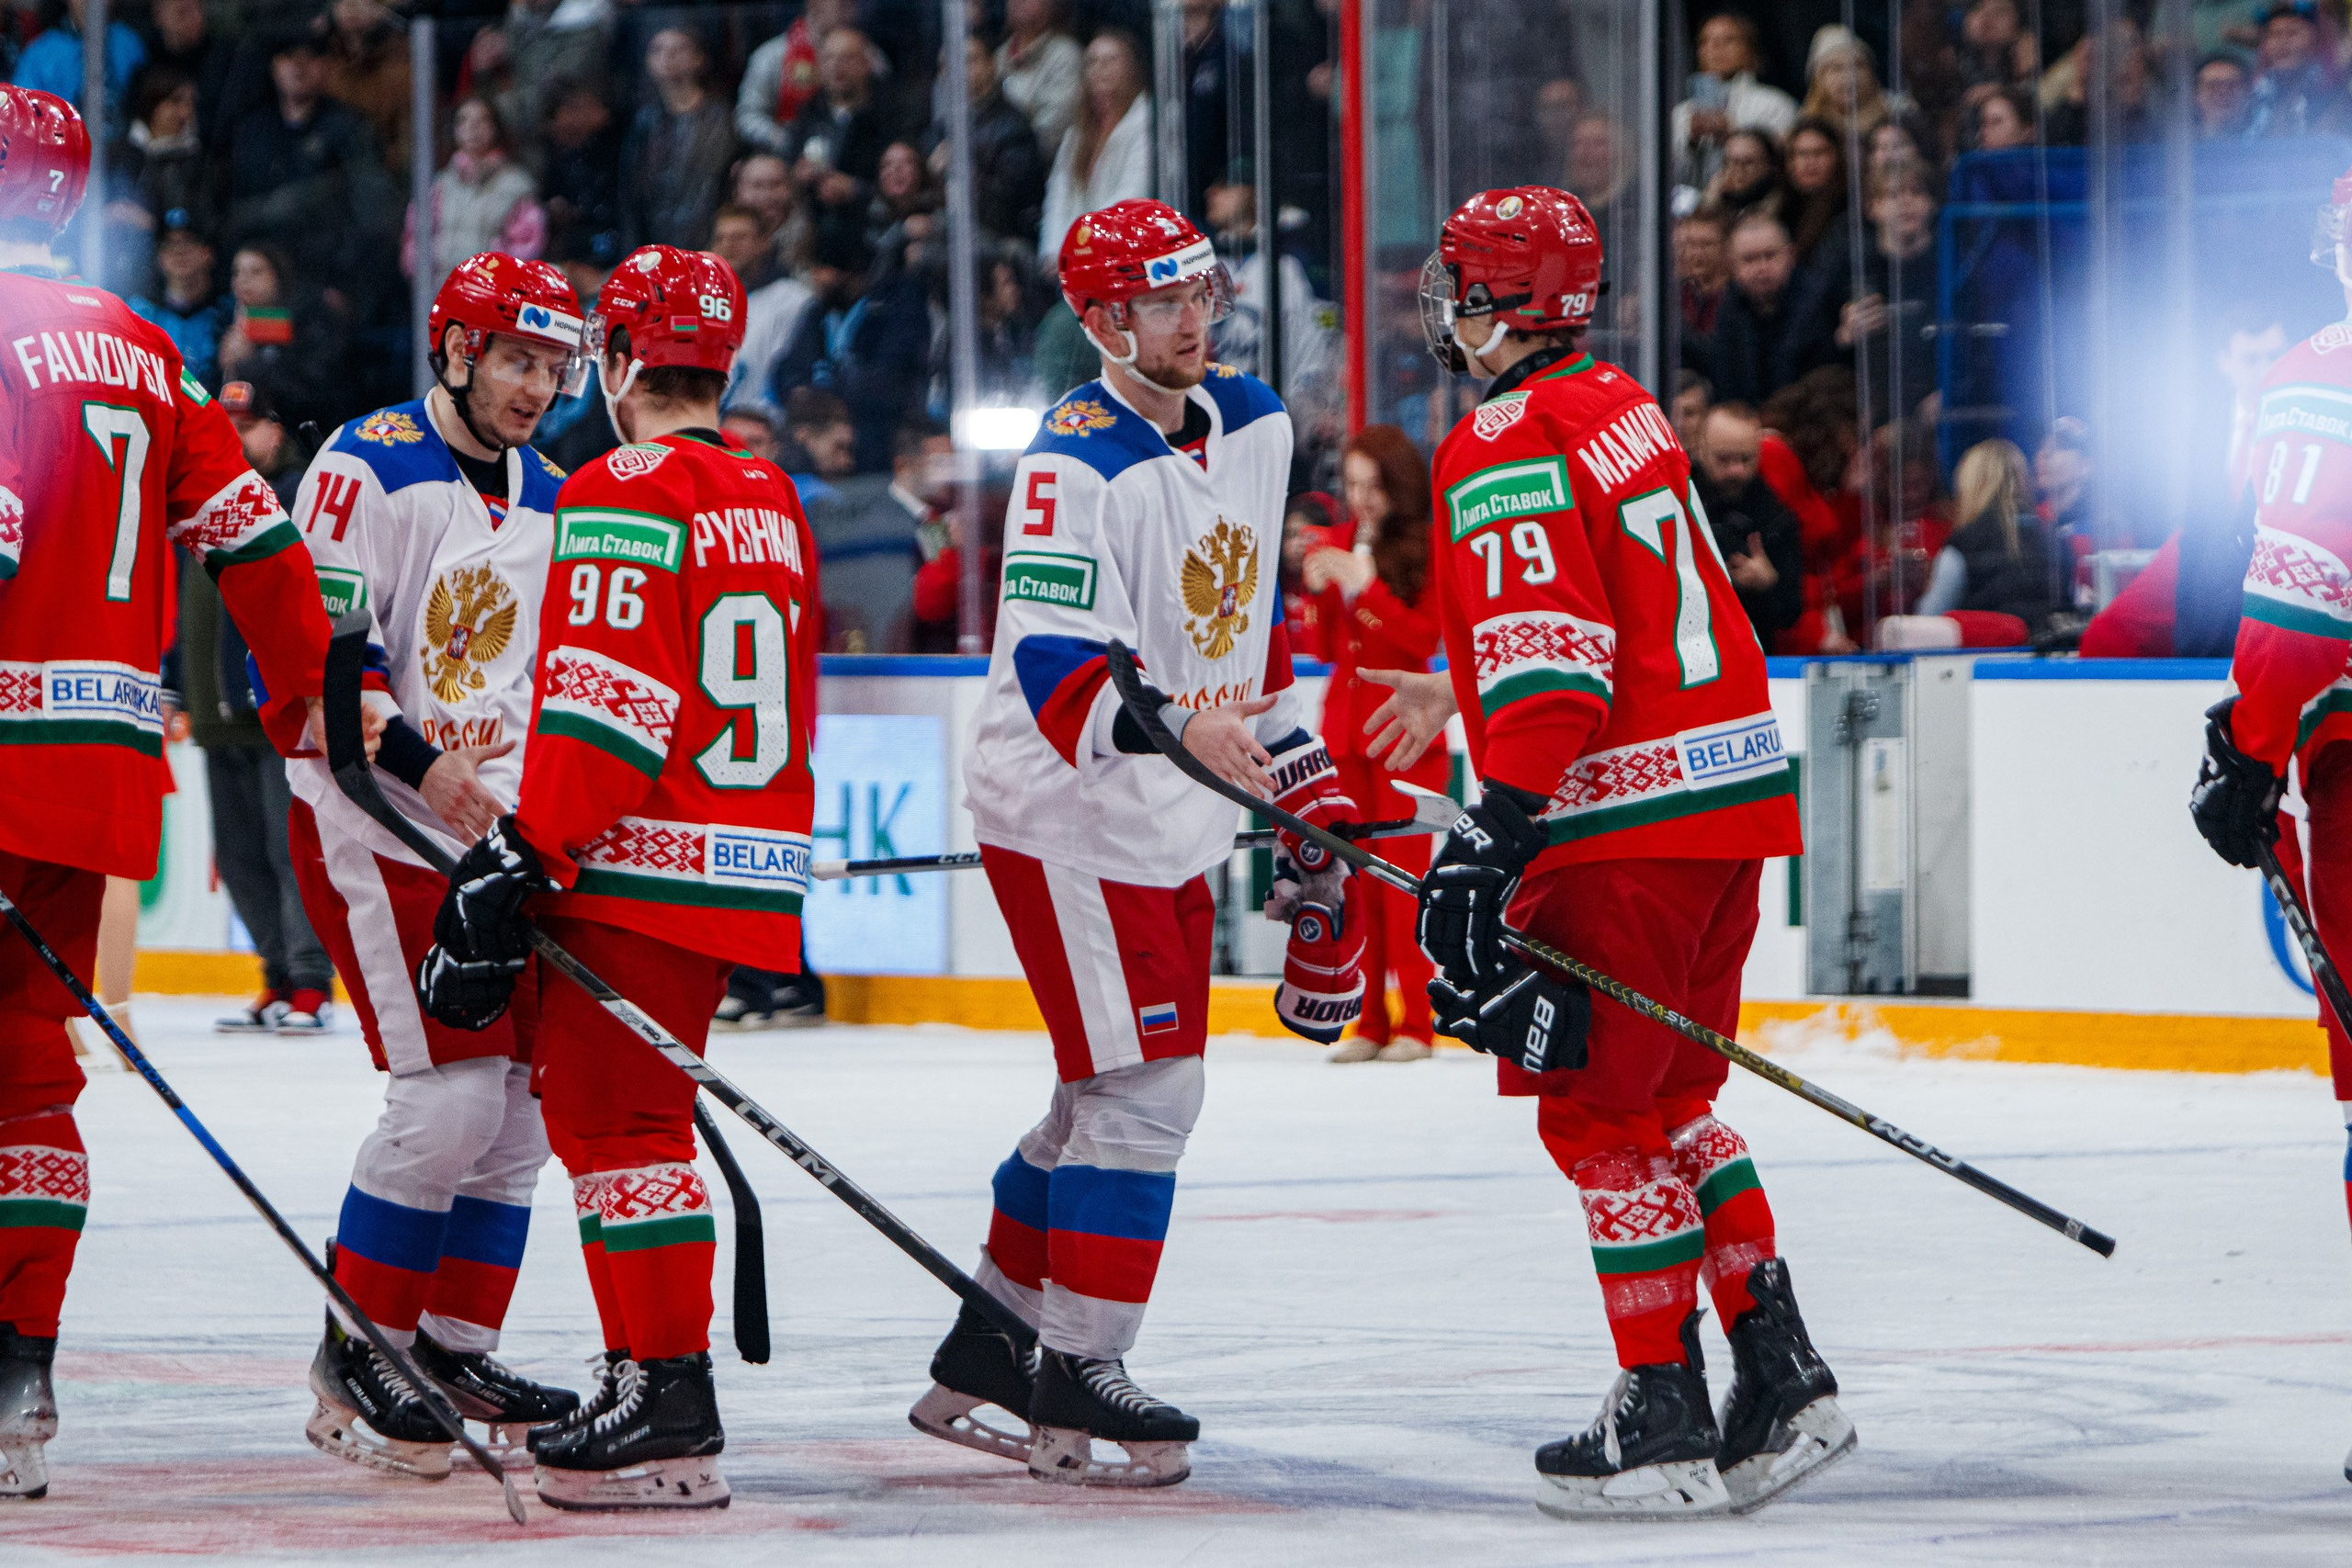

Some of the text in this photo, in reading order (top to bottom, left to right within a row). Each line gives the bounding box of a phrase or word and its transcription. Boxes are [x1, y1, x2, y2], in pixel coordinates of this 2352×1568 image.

[49, 169, 65, 193] 7
[611, 296, 638, 310] CCM
[698, 294, 732, 321] 96
[1560, 292, 1588, 318] 79
[81, 399, 152, 604] 7
[1022, 471, 1057, 537] 5
[2263, 439, 2324, 505] 81
[305, 470, 362, 544] 14
[1469, 520, 1558, 599] 79
[1617, 476, 1765, 691] 7
[567, 563, 649, 631] 96
[1686, 728, 1784, 773] BELARU
[714, 841, 810, 877] BELARU
[2269, 874, 2327, 972] CCM
[735, 1101, 839, 1188] CCM
[345, 1377, 378, 1416] BAUER
